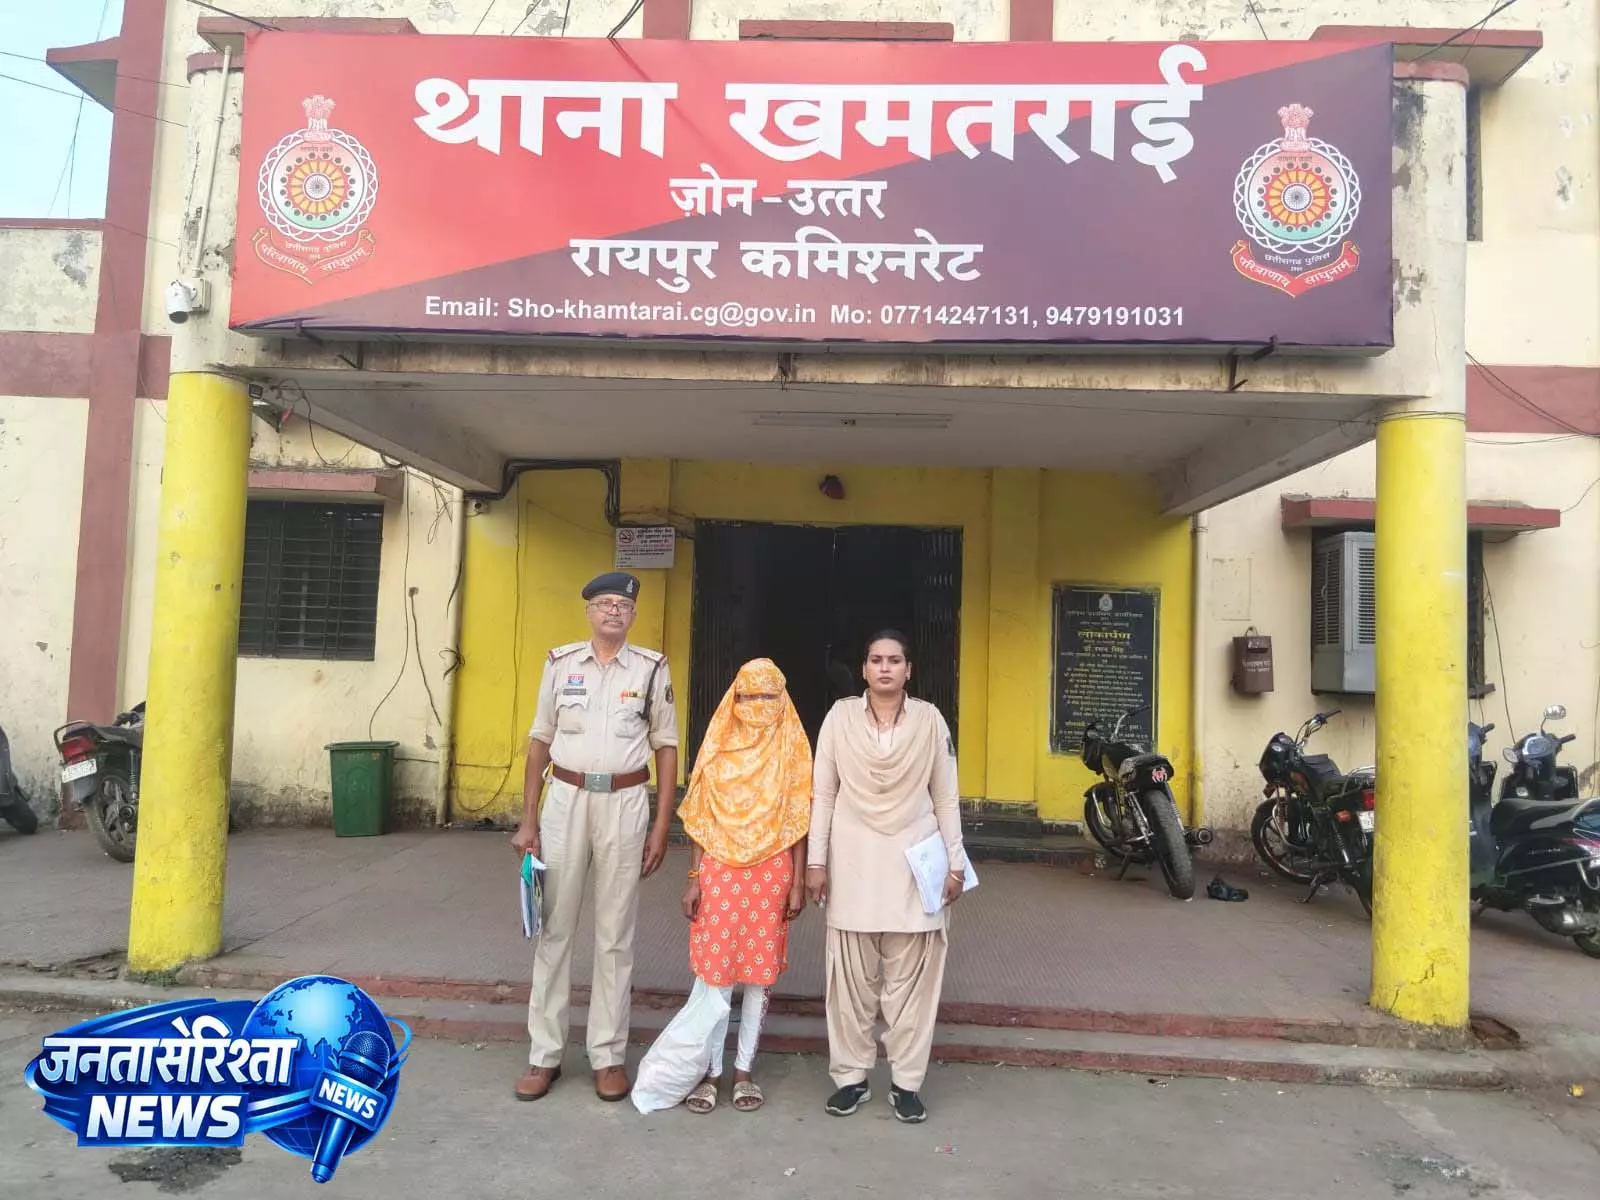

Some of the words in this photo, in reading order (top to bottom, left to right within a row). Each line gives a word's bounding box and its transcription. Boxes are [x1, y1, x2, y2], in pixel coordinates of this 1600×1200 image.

[413, 78, 678, 158] थाना
[725, 44, 1207, 183] खमतराई
[569, 238, 719, 293] रायपुर
[739, 225, 984, 284] कमिश्नरेट
[425, 296, 499, 317] Email:
[507, 299, 816, 327] Sho-khamtarai.cg@gov.in
[830, 304, 873, 325] Mo:
[880, 306, 1038, 329] 07714247131,
[1046, 306, 1184, 326] 9479191031
